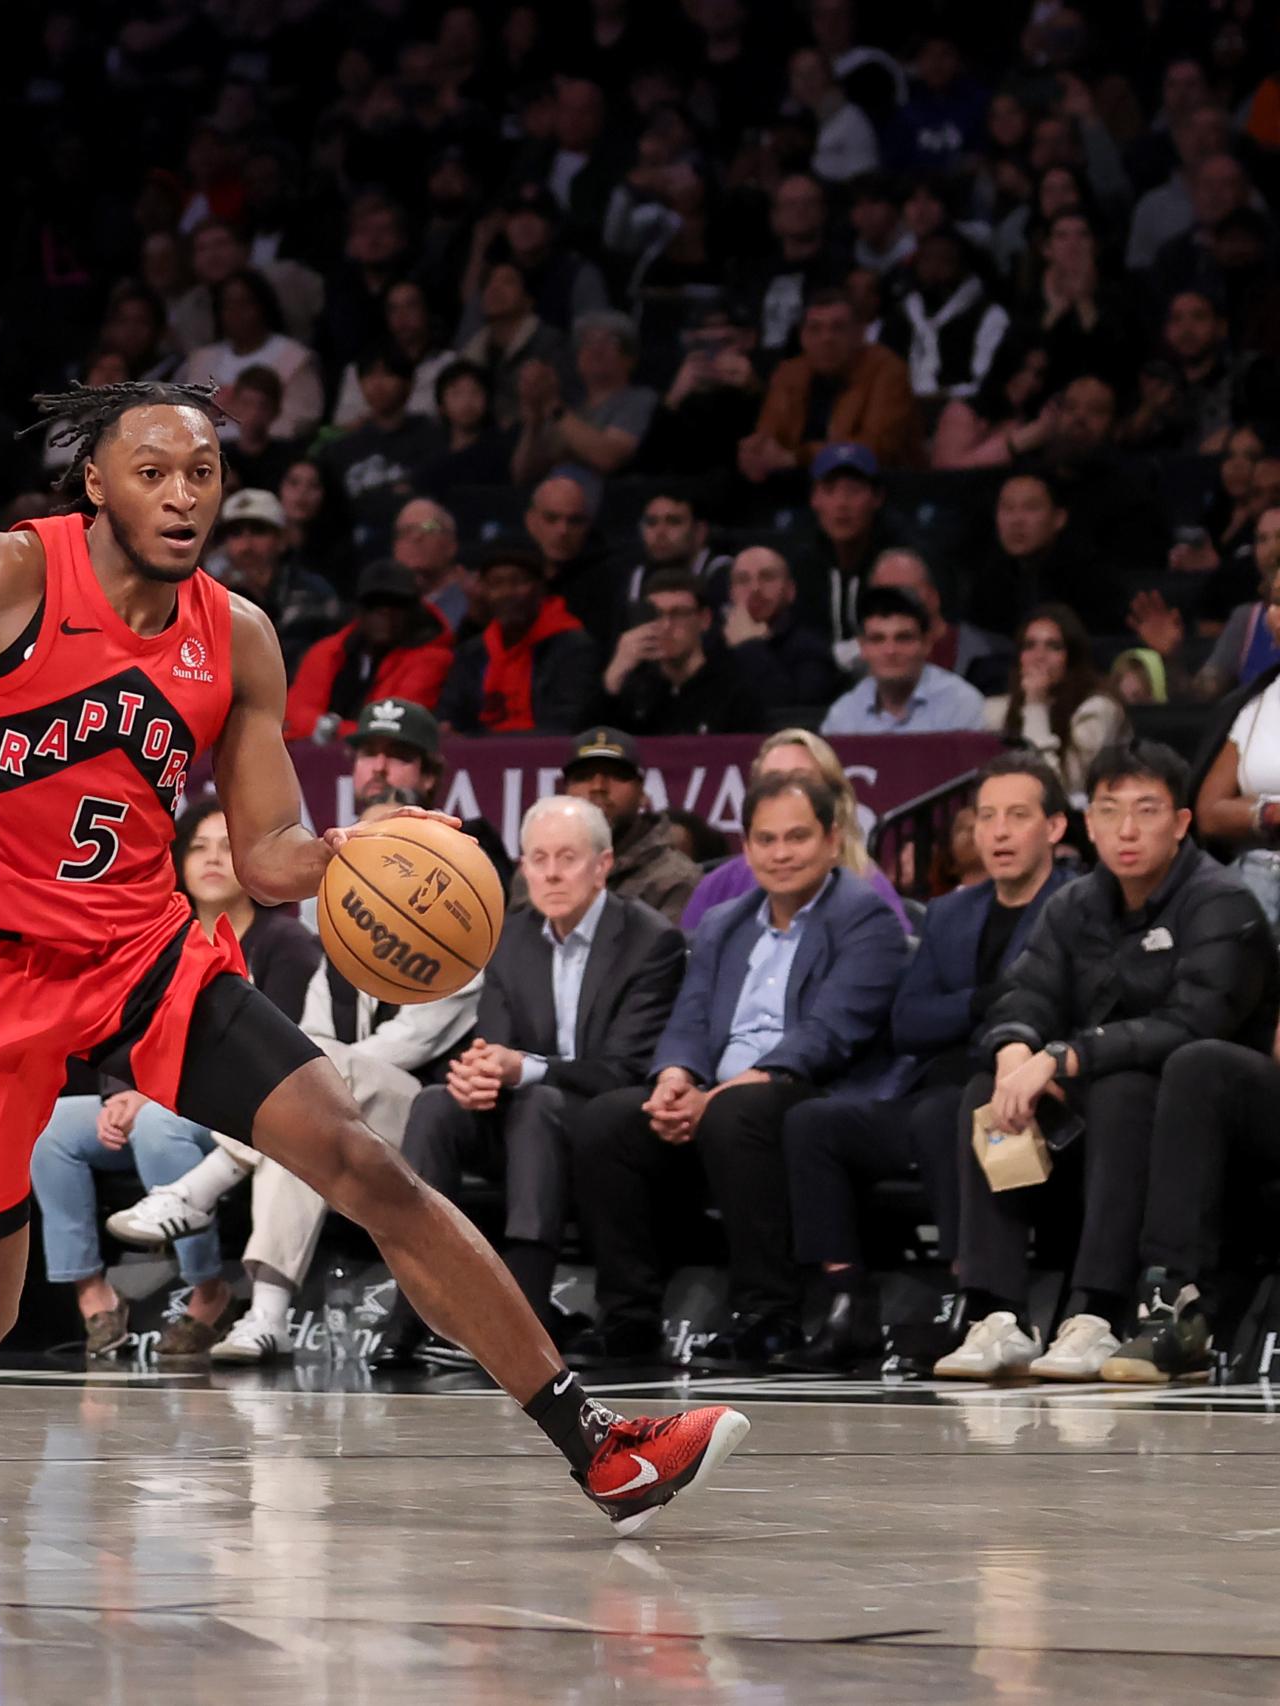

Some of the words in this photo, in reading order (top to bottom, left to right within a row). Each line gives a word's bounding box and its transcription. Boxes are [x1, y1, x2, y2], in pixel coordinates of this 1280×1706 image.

[172, 665, 192, 681] Sun
[193, 669, 214, 684] Life
[56, 794, 130, 882] 5
[340, 885, 442, 986] Wilson
